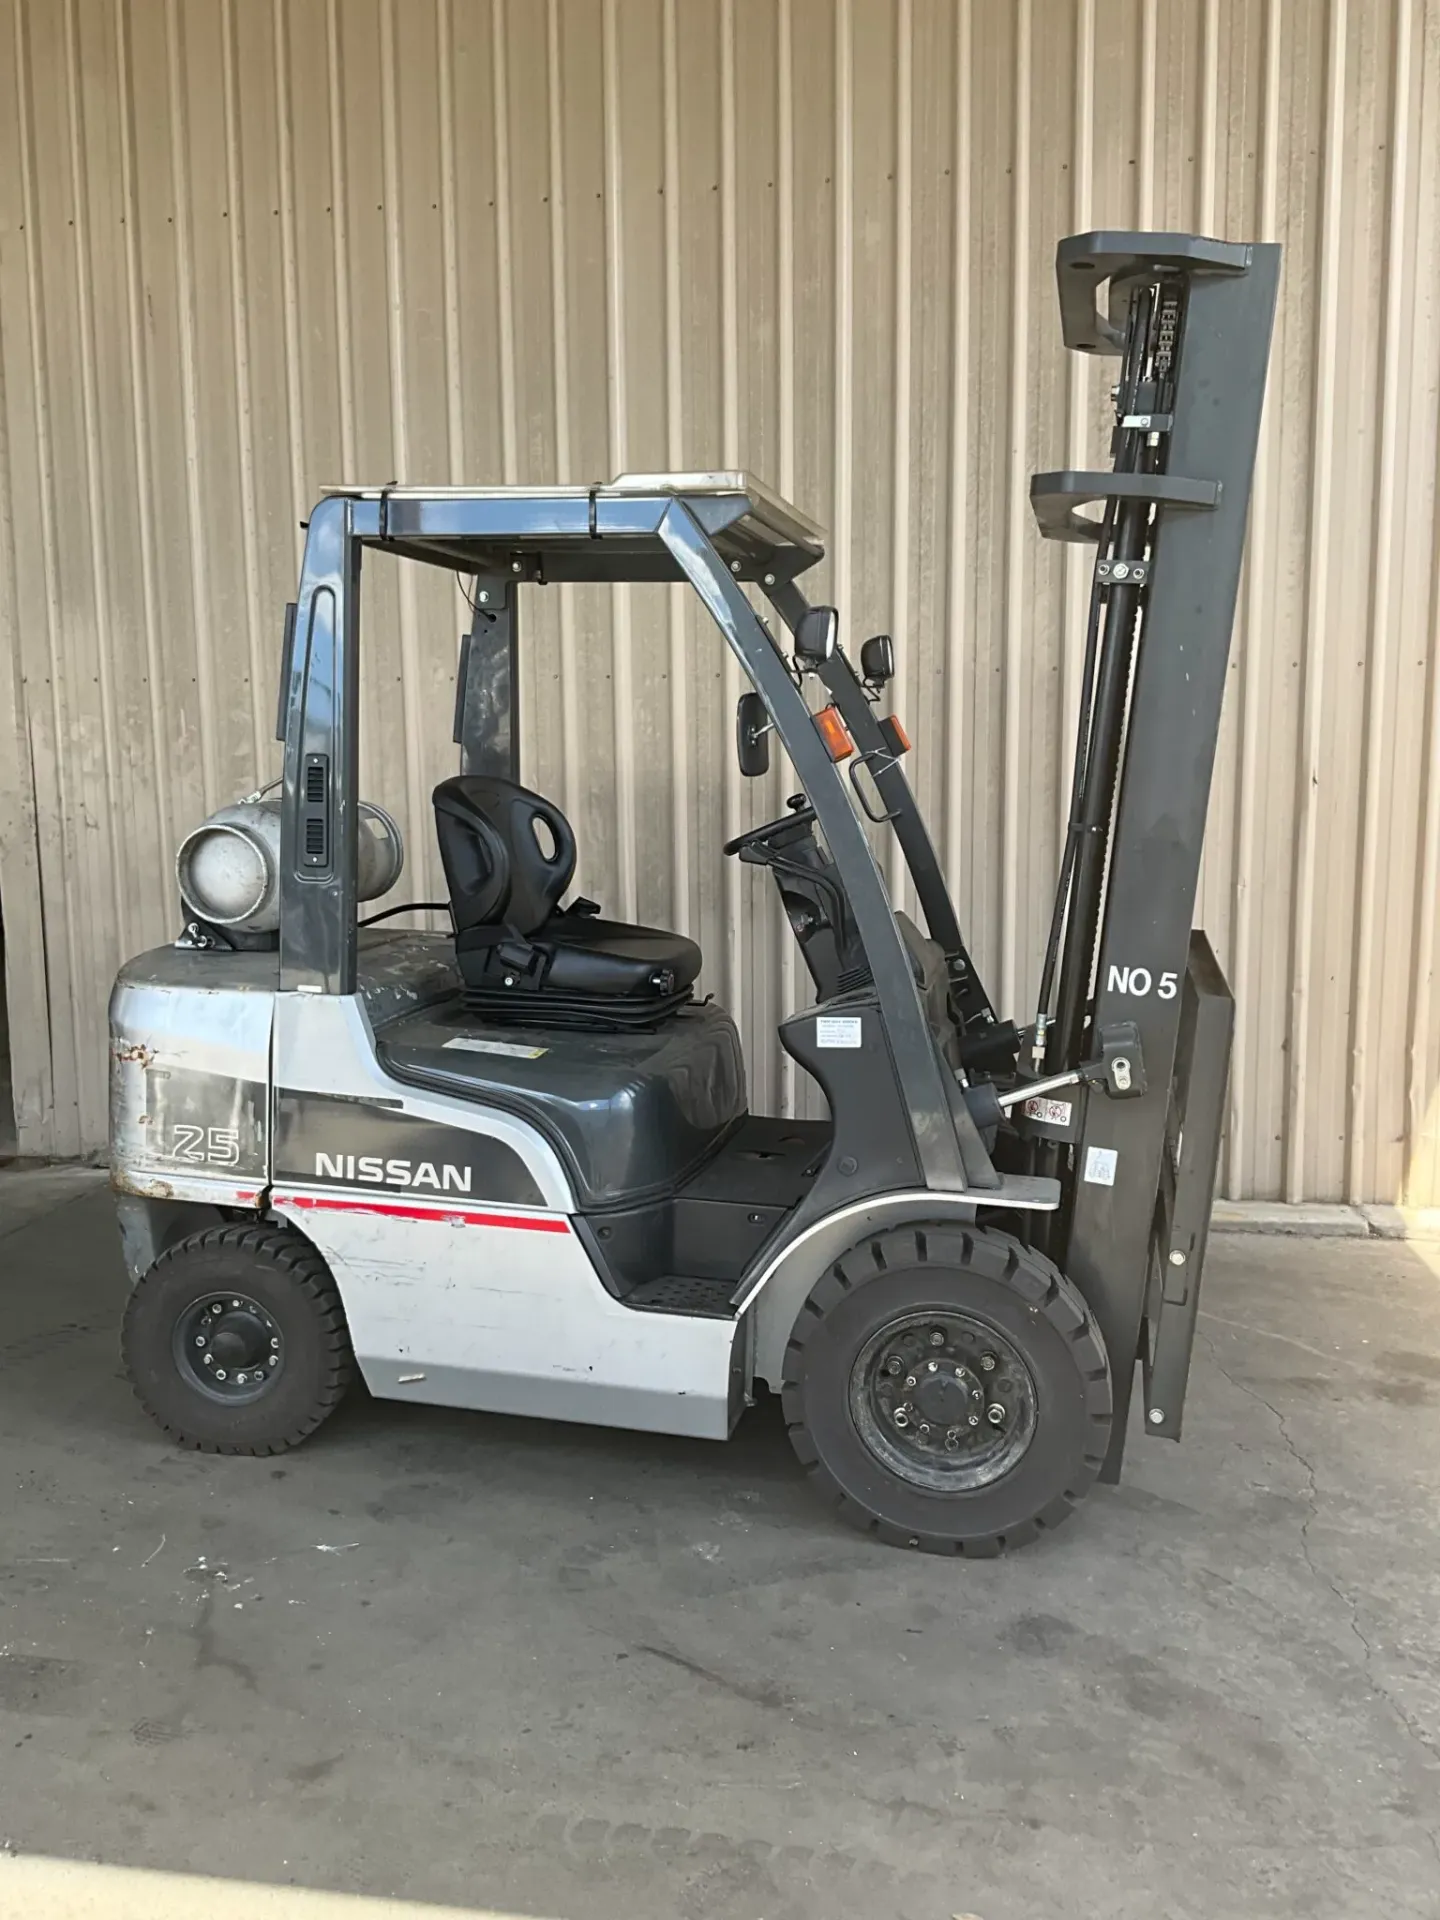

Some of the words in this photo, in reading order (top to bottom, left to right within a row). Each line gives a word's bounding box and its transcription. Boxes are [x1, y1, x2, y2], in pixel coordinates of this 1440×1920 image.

[1107, 965, 1151, 997] NO
[1157, 972, 1178, 999] 5
[172, 1124, 239, 1166] 25
[315, 1153, 472, 1192] NISSAN
